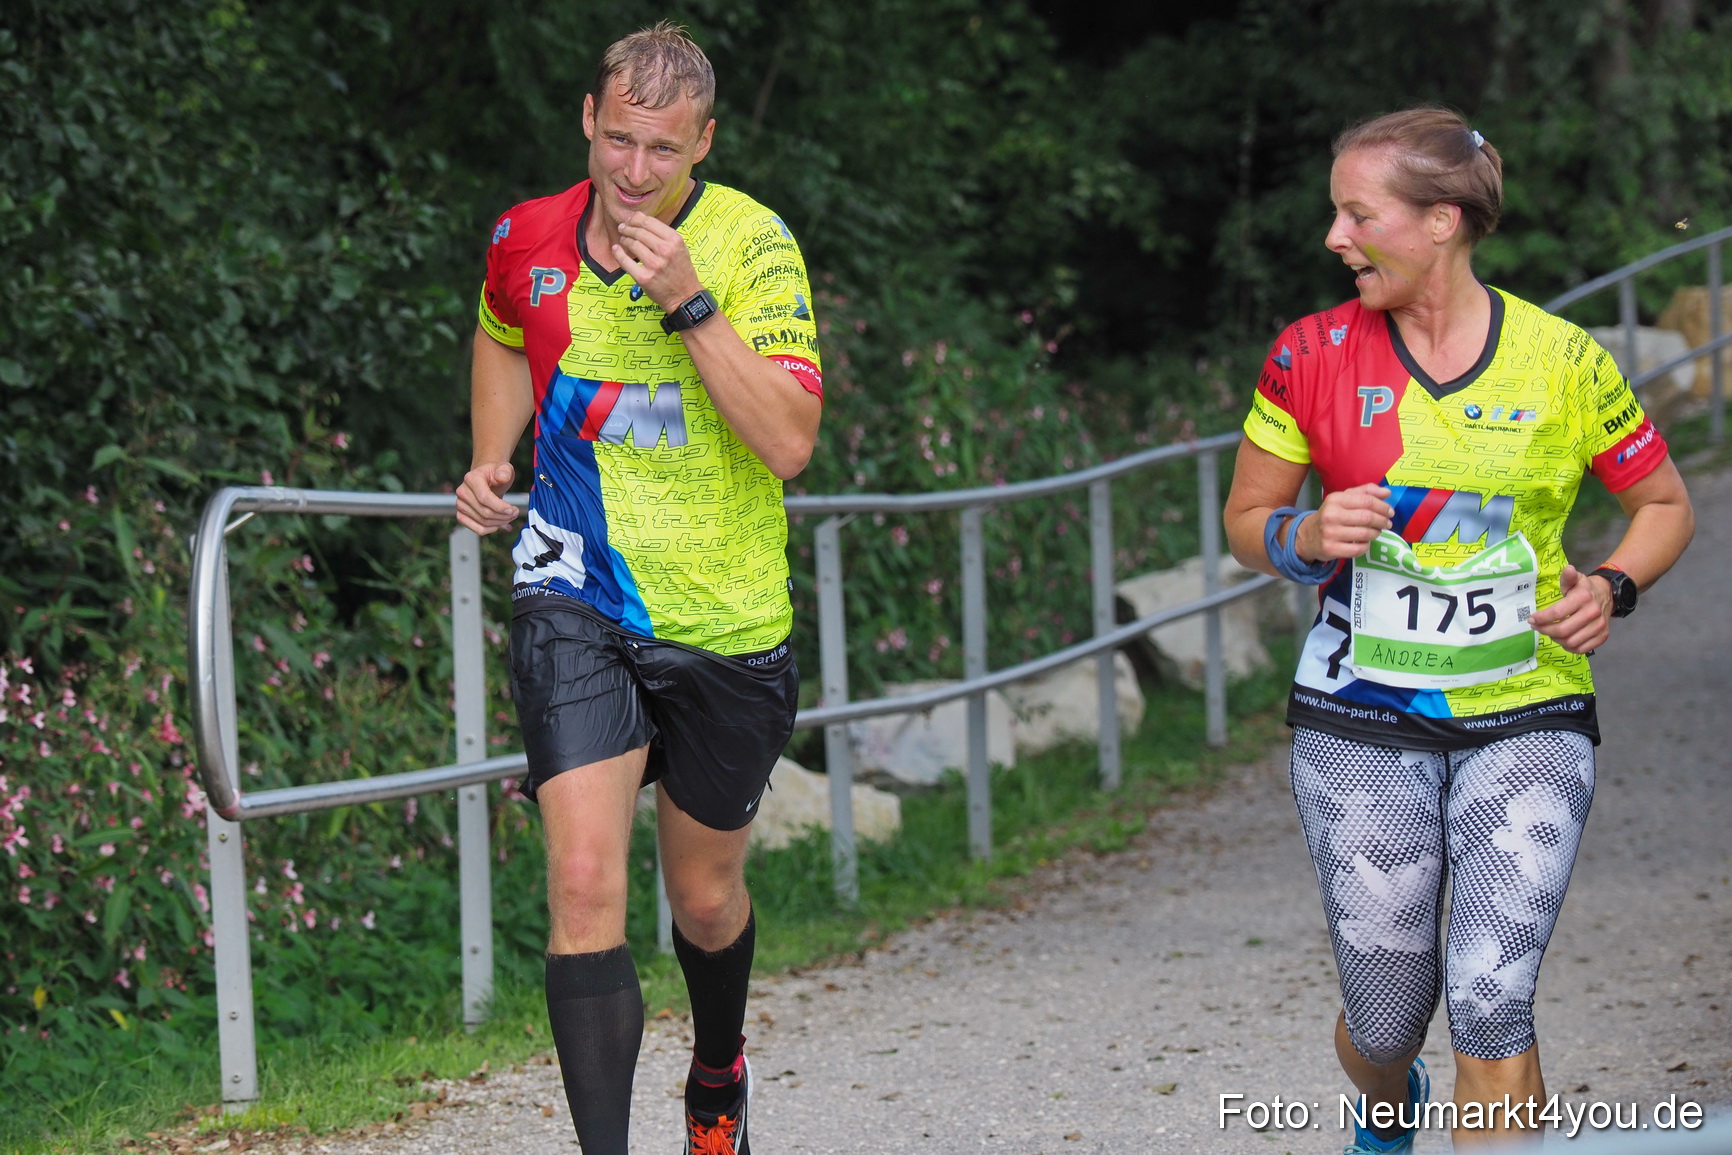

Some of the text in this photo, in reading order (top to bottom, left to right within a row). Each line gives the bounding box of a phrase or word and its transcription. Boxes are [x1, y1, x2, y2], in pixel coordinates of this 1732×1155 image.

[759, 306, 774, 314] THE
[1603, 399, 1637, 435] BMW
[1396, 584, 1496, 636] 175
[1371, 643, 1454, 668] ANDREA
[1294, 690, 1397, 723] www.bmw-partl.de
[1463, 699, 1585, 730] www.bmw-partl.de
